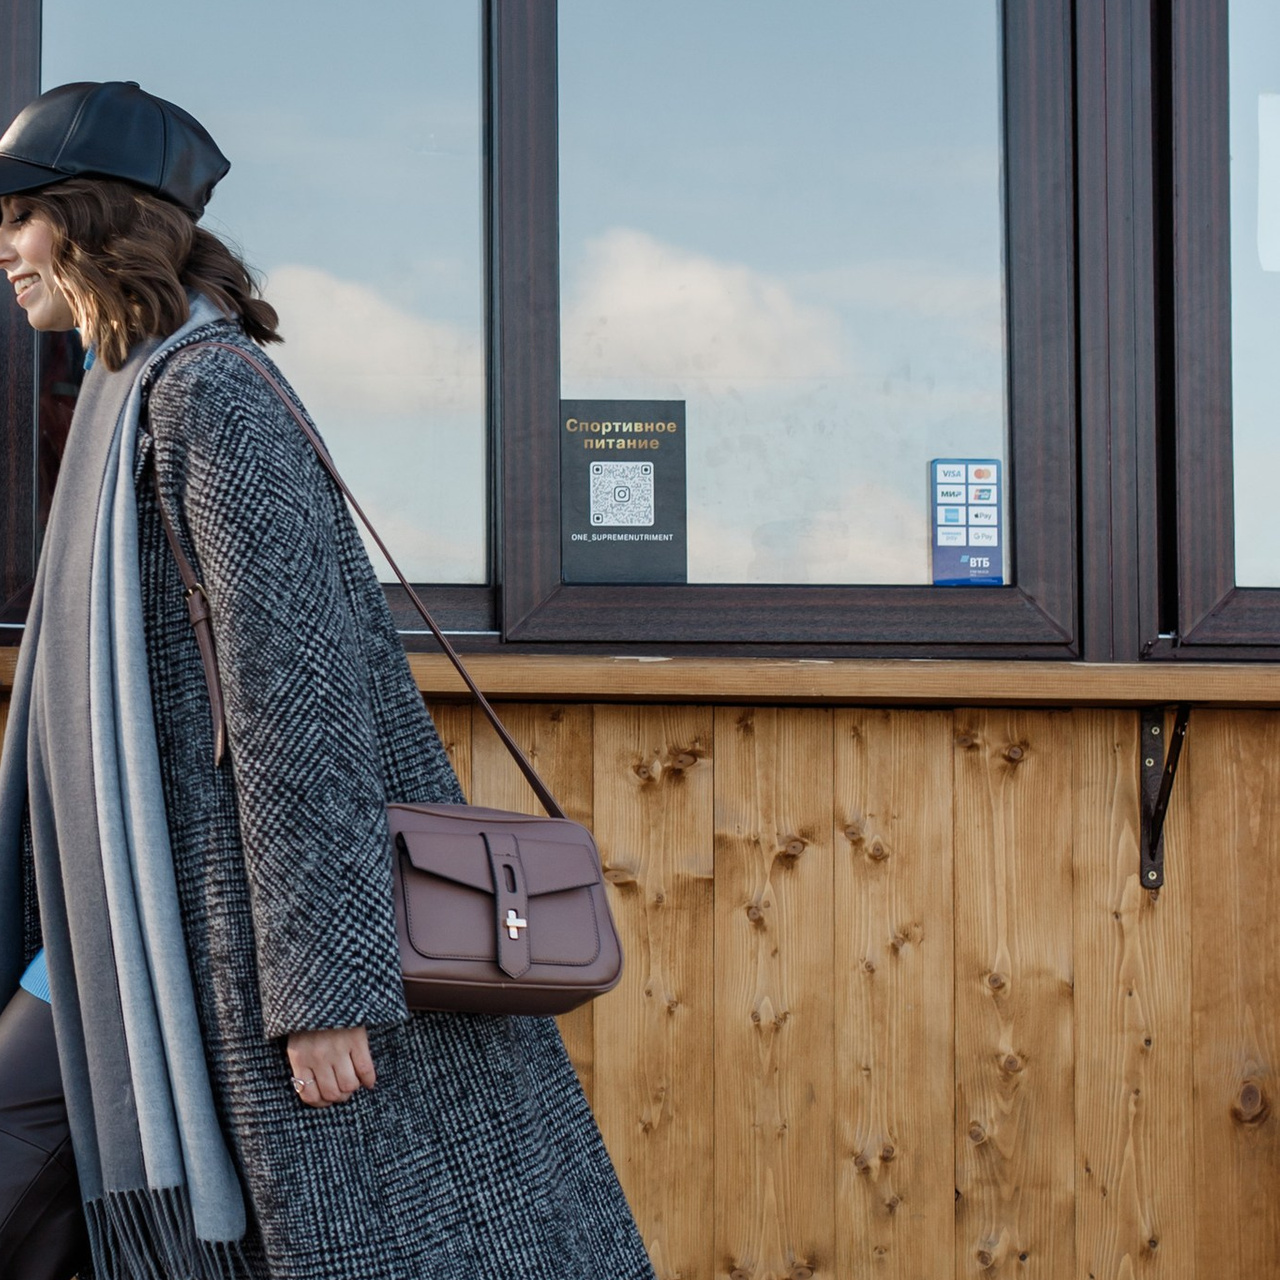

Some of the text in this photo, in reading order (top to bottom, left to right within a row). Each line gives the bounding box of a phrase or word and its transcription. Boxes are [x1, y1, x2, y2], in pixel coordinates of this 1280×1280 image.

[565, 418, 677, 435] Спортивное
[583, 437, 660, 450] питание
[942, 469, 962, 478] VISA
[571, 533, 674, 543] ONE_SUPREMENUTRIMENT
[969, 557, 990, 568] ВТБ
